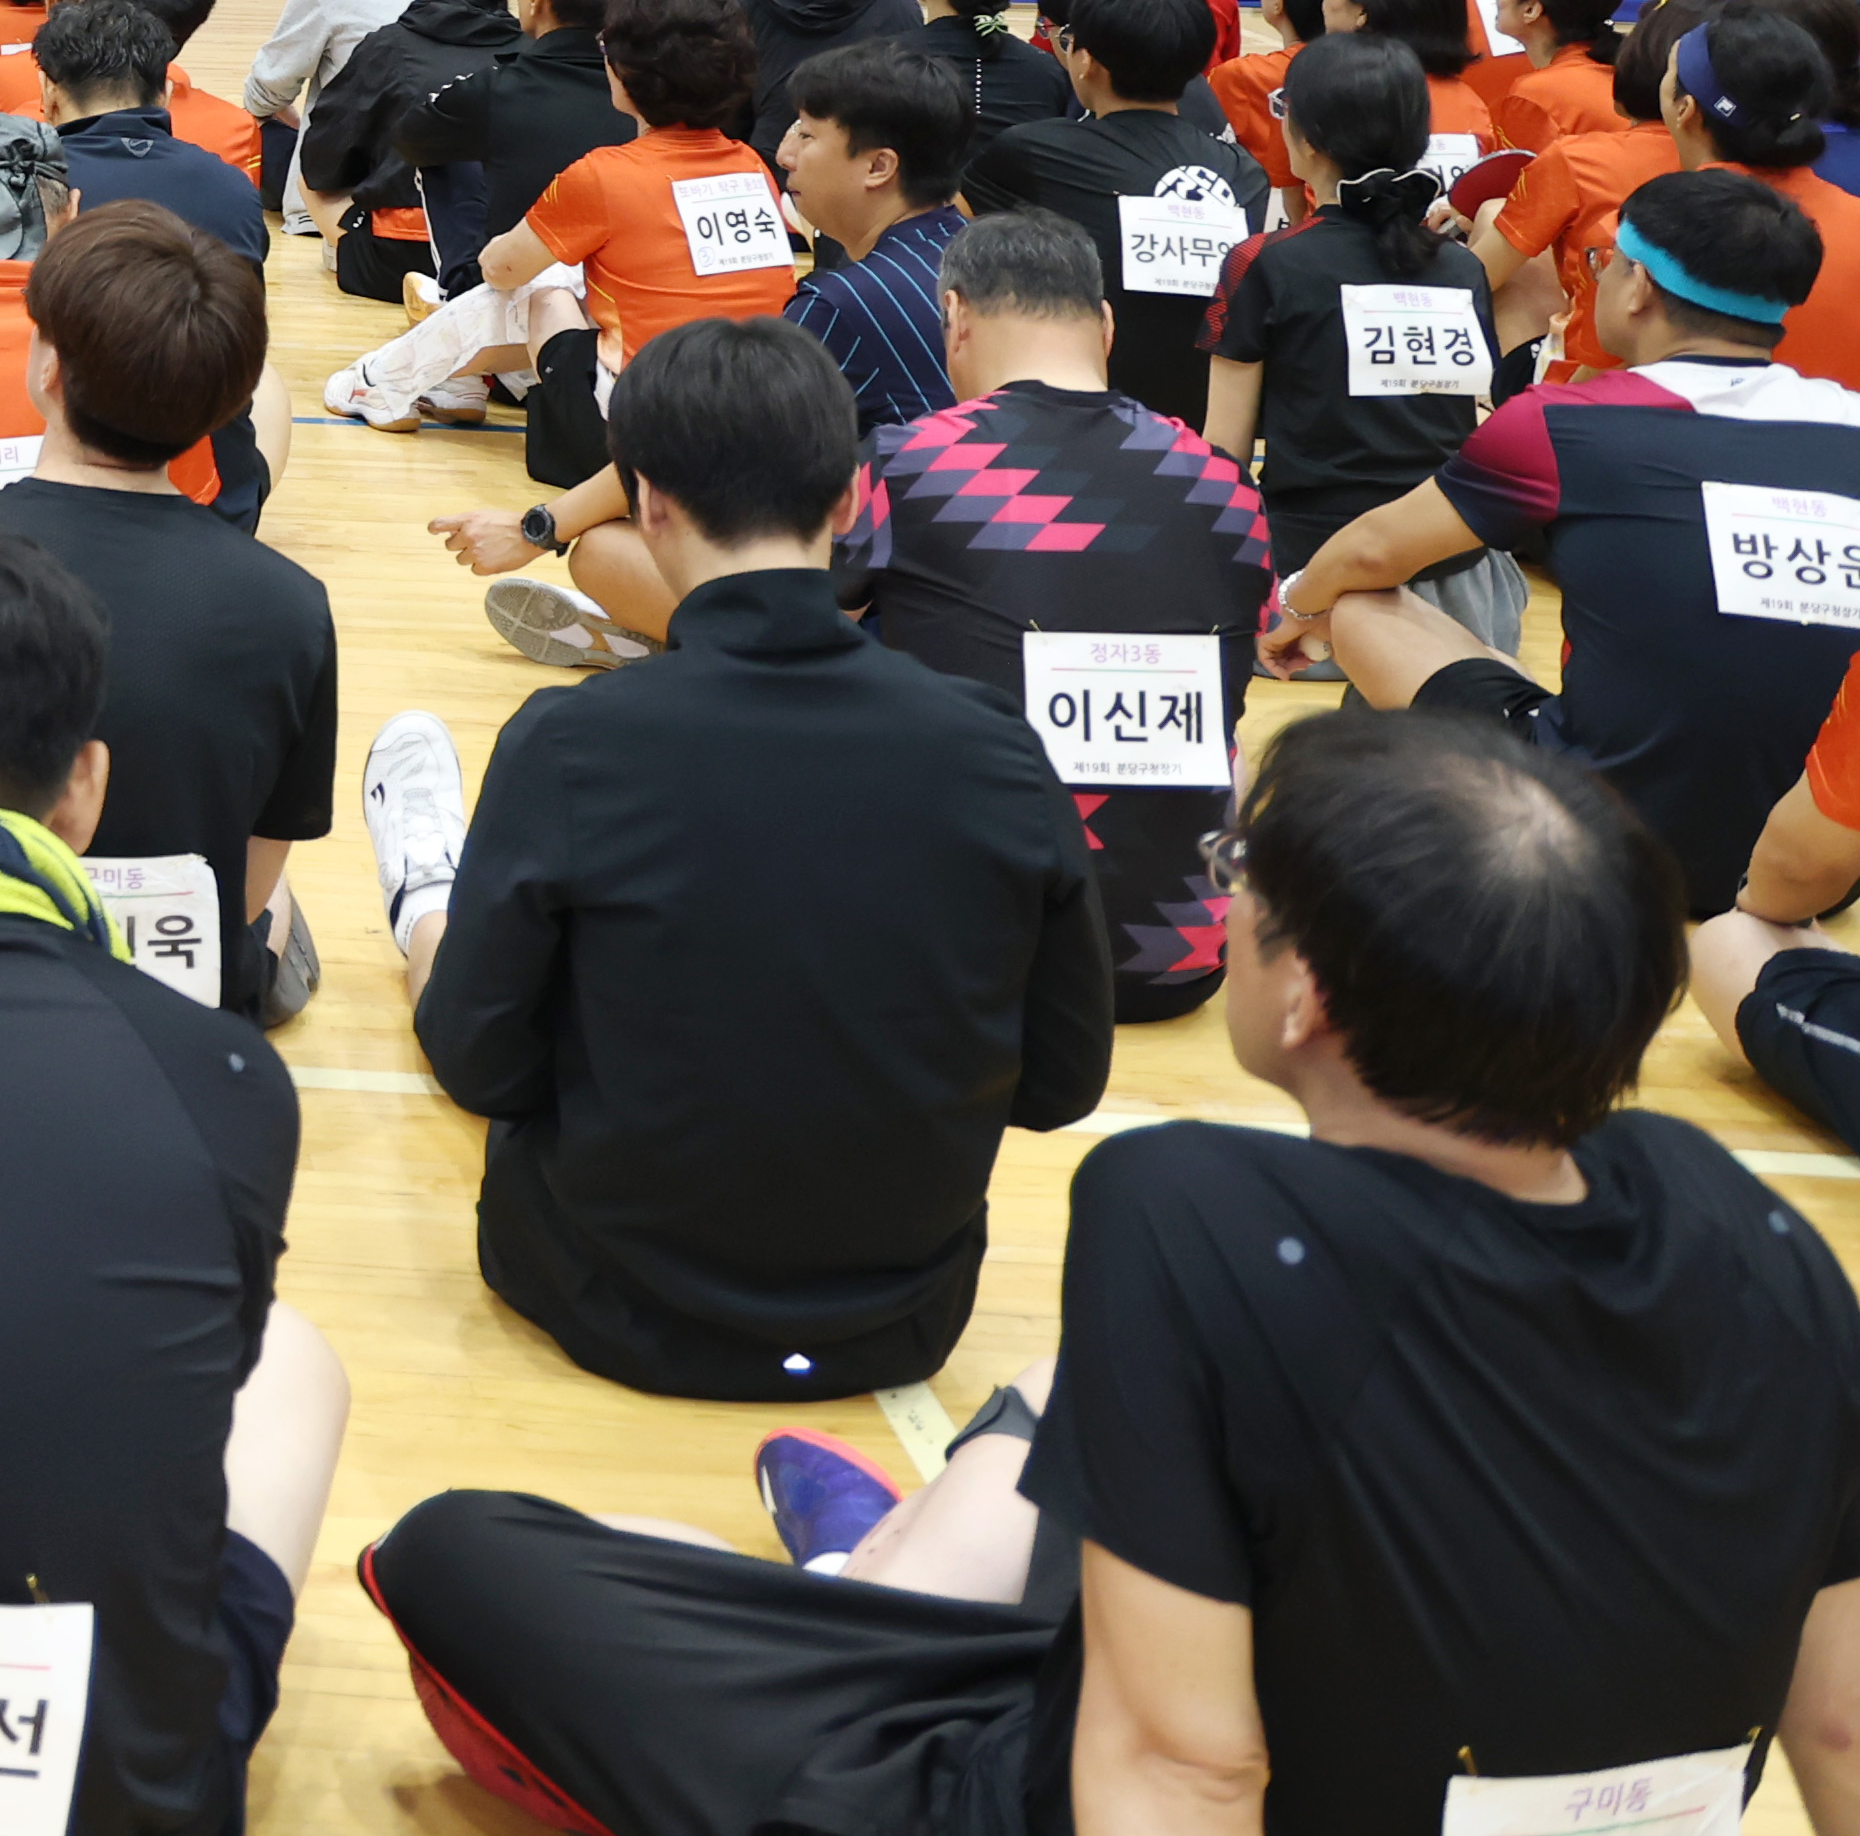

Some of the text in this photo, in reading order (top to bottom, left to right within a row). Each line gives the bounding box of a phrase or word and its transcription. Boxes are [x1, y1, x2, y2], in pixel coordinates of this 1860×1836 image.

[1167, 204, 1205, 221] 백현동
[697, 207, 777, 247] 이영숙
[1392, 291, 1434, 309] 백현동
[1363, 324, 1476, 367] 김현경
[1771, 494, 1828, 518] 백현동
[1760, 596, 1794, 612] 제19회
[1089, 642, 1162, 666] 정자3동
[1048, 690, 1204, 746] 이신제
[1073, 759, 1183, 776] 제19회 분당구청장기
[1565, 1778, 1655, 1819] 구미동
